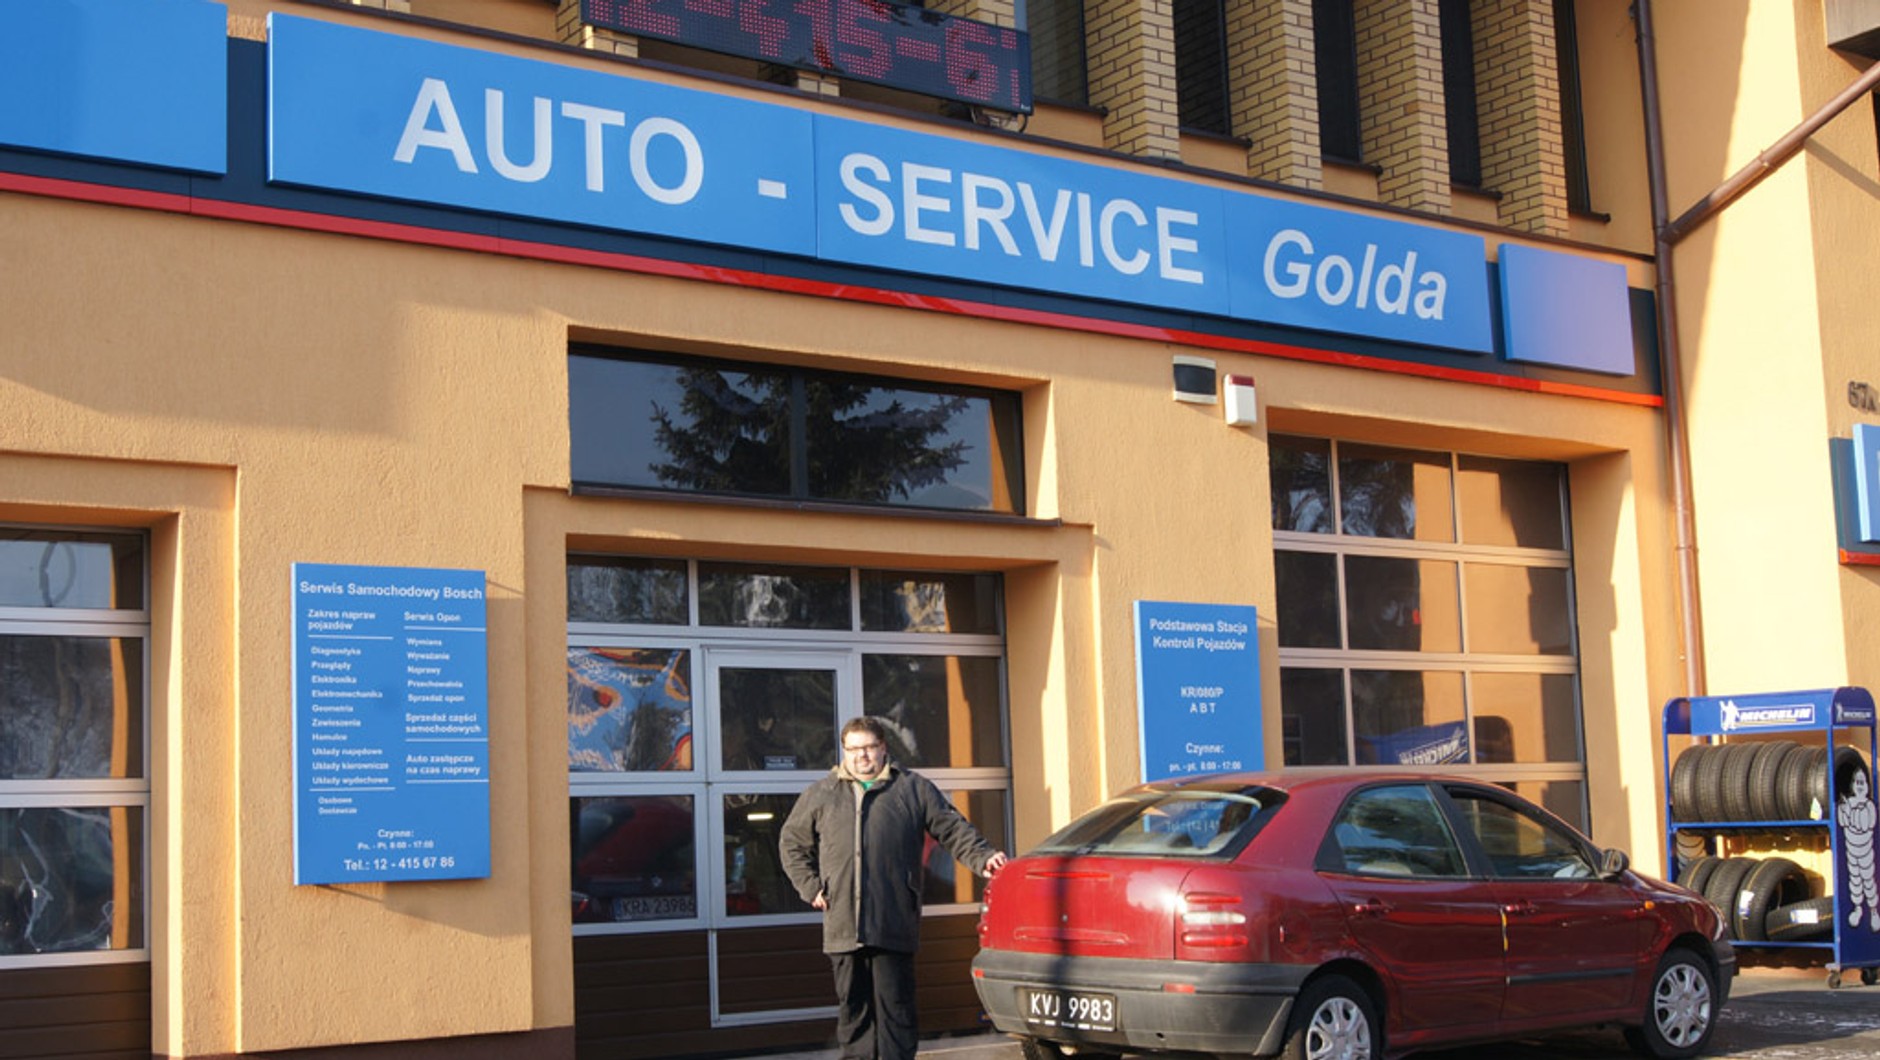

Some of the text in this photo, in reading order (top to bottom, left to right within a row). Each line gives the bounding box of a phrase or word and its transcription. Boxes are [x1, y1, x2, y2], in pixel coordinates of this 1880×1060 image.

[393, 77, 1447, 321] AUTO - SERVICE Golda
[300, 581, 482, 600] Serwis Samochodowy Bosch
[308, 609, 376, 620] Zakres napraw
[404, 612, 461, 623] Serwis Opon
[308, 620, 353, 631] pojazdów
[1150, 618, 1248, 635] Podstawowa Stacja
[1153, 636, 1245, 652] Kontroli Pojazdów
[311, 646, 361, 656] Diagnostyka
[408, 665, 441, 675] Naprawy
[312, 675, 357, 684] Elektronika
[312, 690, 383, 699] Elektromechanika
[312, 704, 354, 713] Geometria
[1190, 703, 1216, 713] A B T
[405, 713, 477, 724] Sprzedaż części
[1740, 708, 1811, 722] MICHELIN
[405, 724, 481, 734] samochodowych
[312, 733, 347, 741] Hamulce
[1186, 742, 1225, 756] Czynne:
[406, 754, 475, 765] Auto zastępcze
[406, 766, 481, 775] na czas naprawy
[378, 829, 414, 839] Czynne:
[344, 860, 370, 871] Tel.:
[373, 859, 387, 870] 12
[399, 858, 420, 869] 415
[423, 857, 438, 868] 67
[1031, 992, 1112, 1022] KVJ 9983
